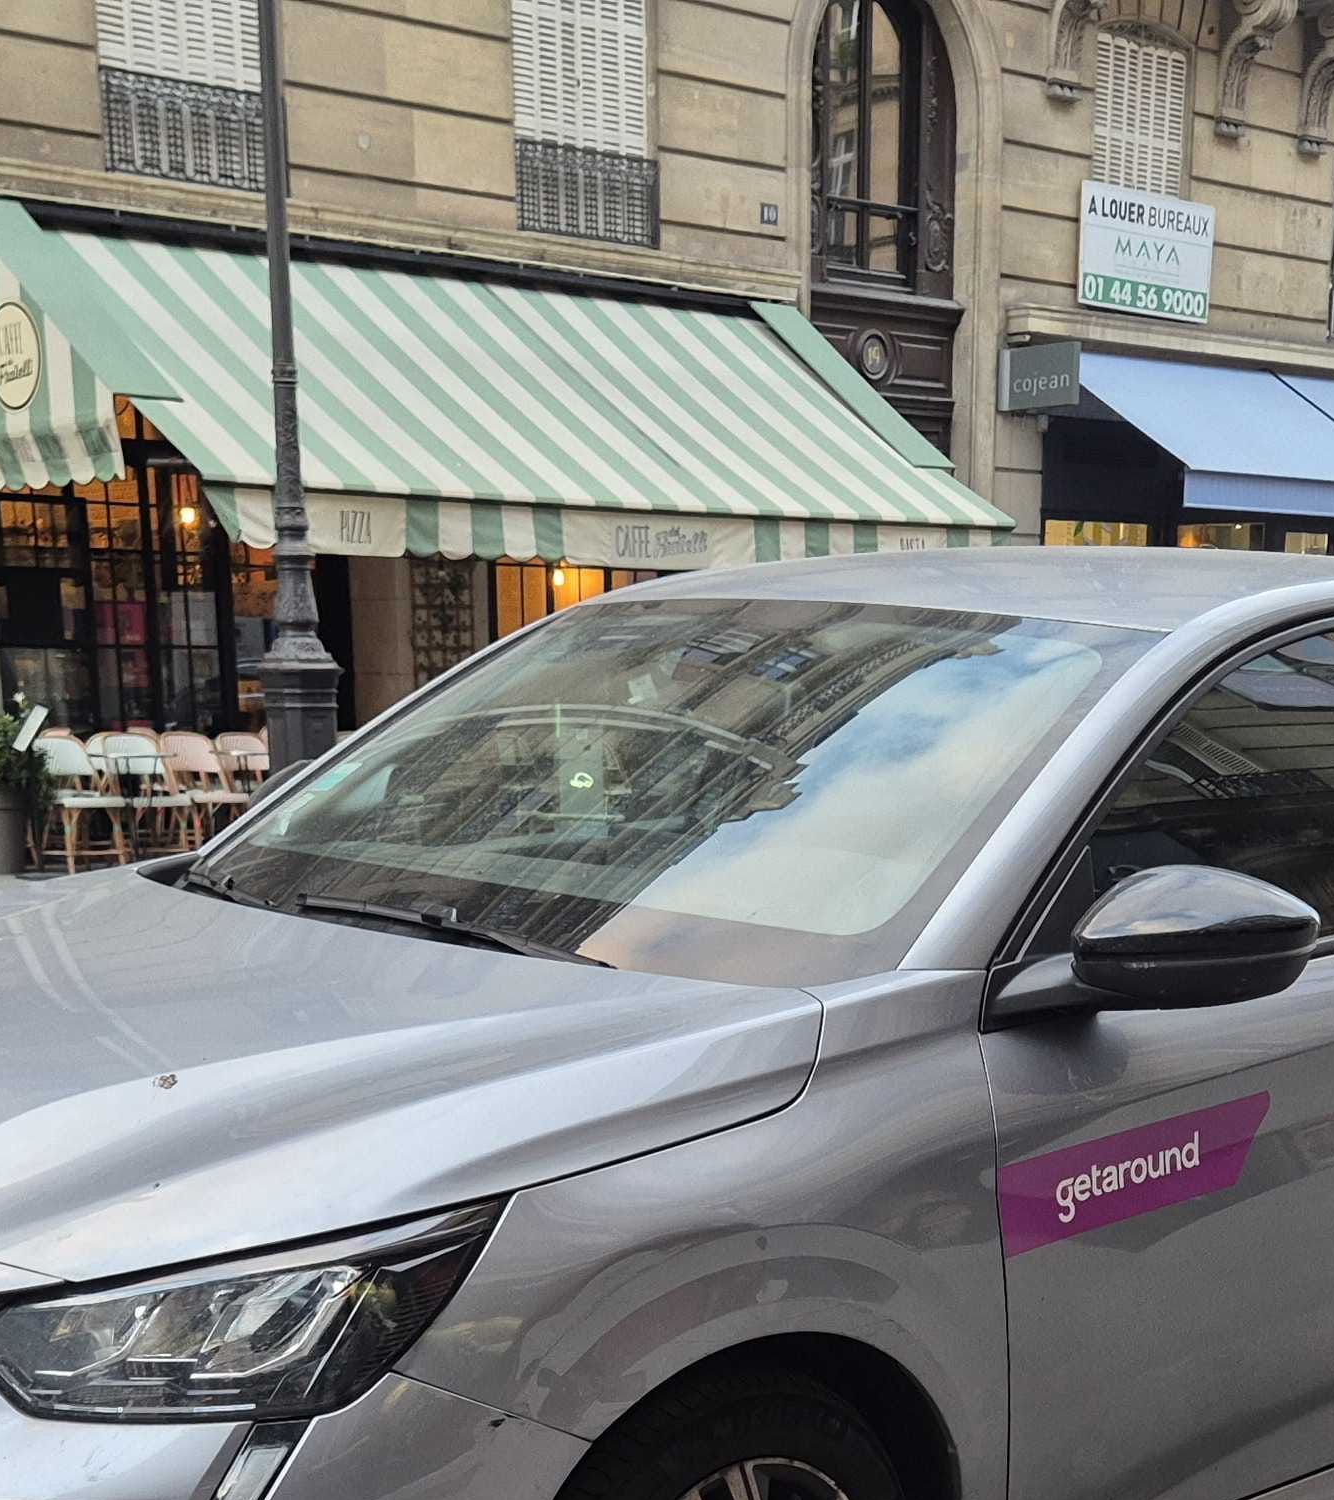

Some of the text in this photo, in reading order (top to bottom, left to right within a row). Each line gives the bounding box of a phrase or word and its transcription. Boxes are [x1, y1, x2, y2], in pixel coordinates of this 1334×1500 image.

[1088, 195, 1209, 237] A LOUER BUREAUX
[1115, 236, 1180, 265] MAYA
[1084, 275, 1104, 300] 01
[1110, 280, 1132, 304] 44
[1137, 284, 1158, 309] 56
[1163, 288, 1205, 317] 9000
[1013, 371, 1070, 396] cojean
[340, 510, 372, 545] PIZZA
[1056, 1130, 1200, 1224] getaround
